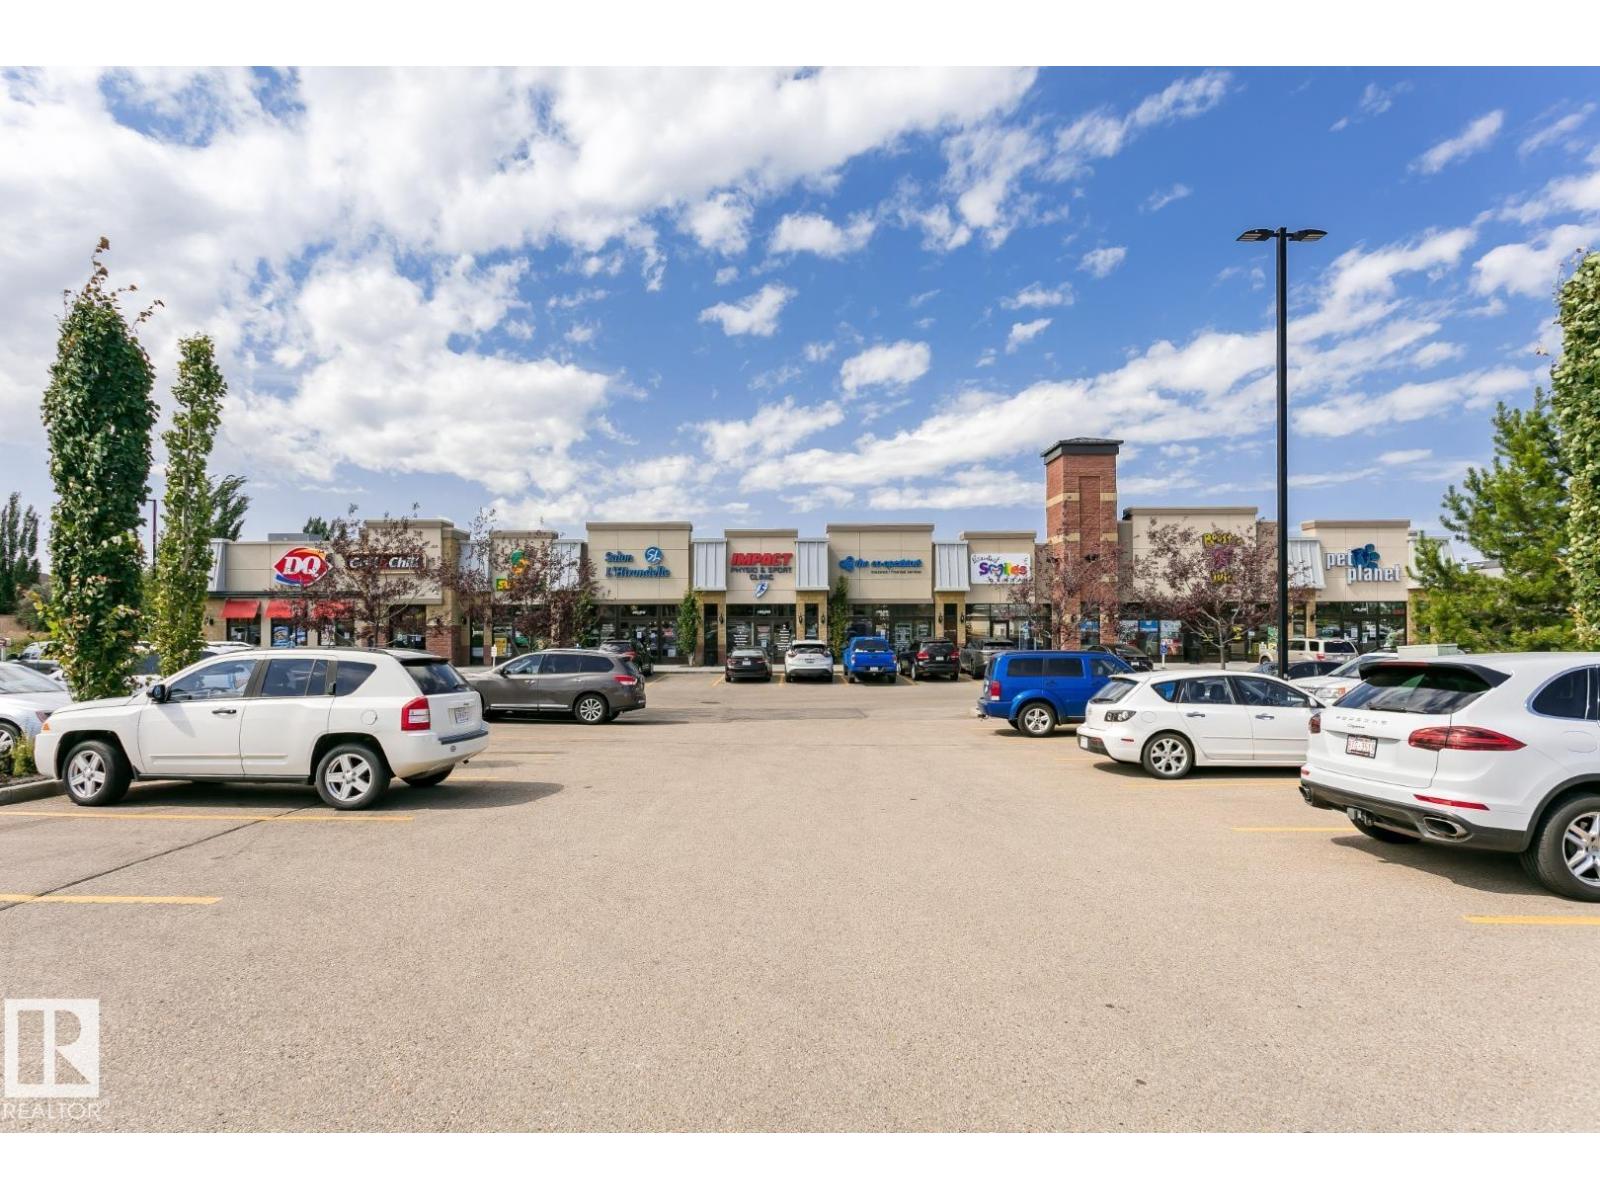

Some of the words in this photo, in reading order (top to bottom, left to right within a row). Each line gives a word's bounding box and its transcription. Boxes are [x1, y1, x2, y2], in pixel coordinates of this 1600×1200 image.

[283, 556, 322, 577] DQ
[731, 552, 793, 566] IMPACT
[1326, 549, 1353, 570] pet
[1347, 564, 1401, 585] planet
